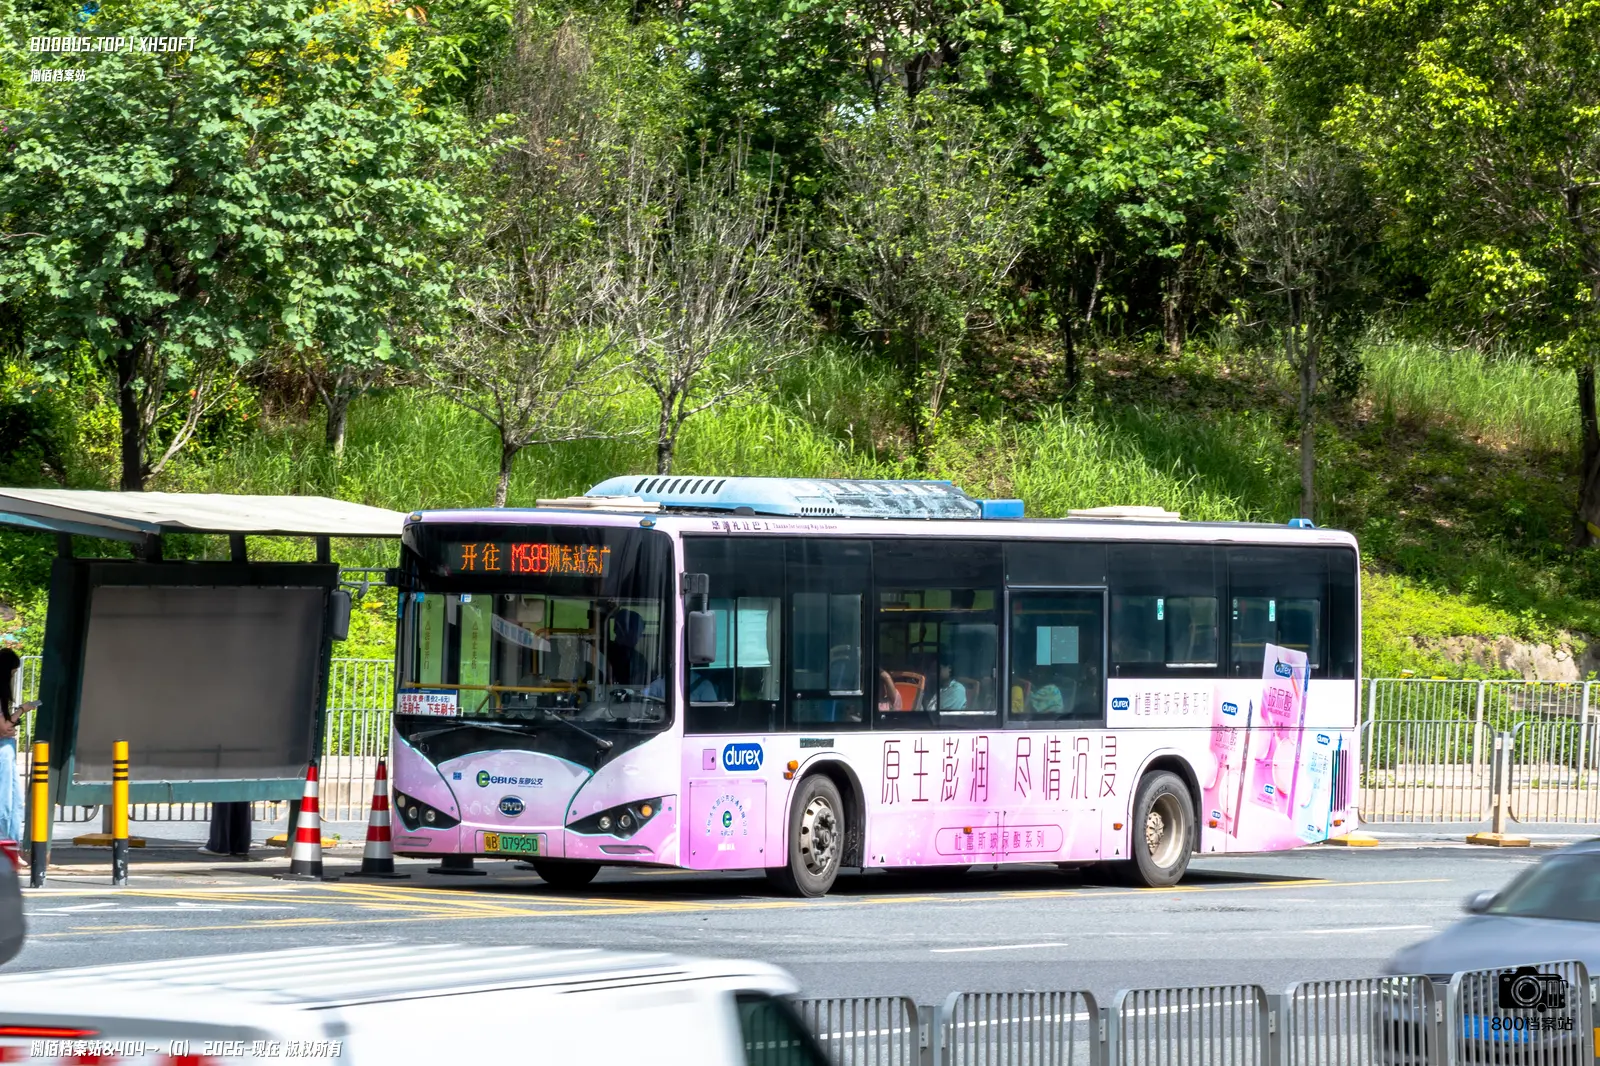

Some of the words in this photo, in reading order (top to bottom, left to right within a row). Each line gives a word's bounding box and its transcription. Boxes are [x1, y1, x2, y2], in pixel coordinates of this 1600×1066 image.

[460, 543, 501, 571] 开往
[511, 543, 550, 573] M589
[1112, 698, 1129, 708] durex
[1222, 703, 1238, 715] durex
[725, 745, 761, 768] durex
[881, 735, 989, 804] 原生澎润
[500, 801, 522, 811] BYD
[502, 836, 538, 852] 07925D
